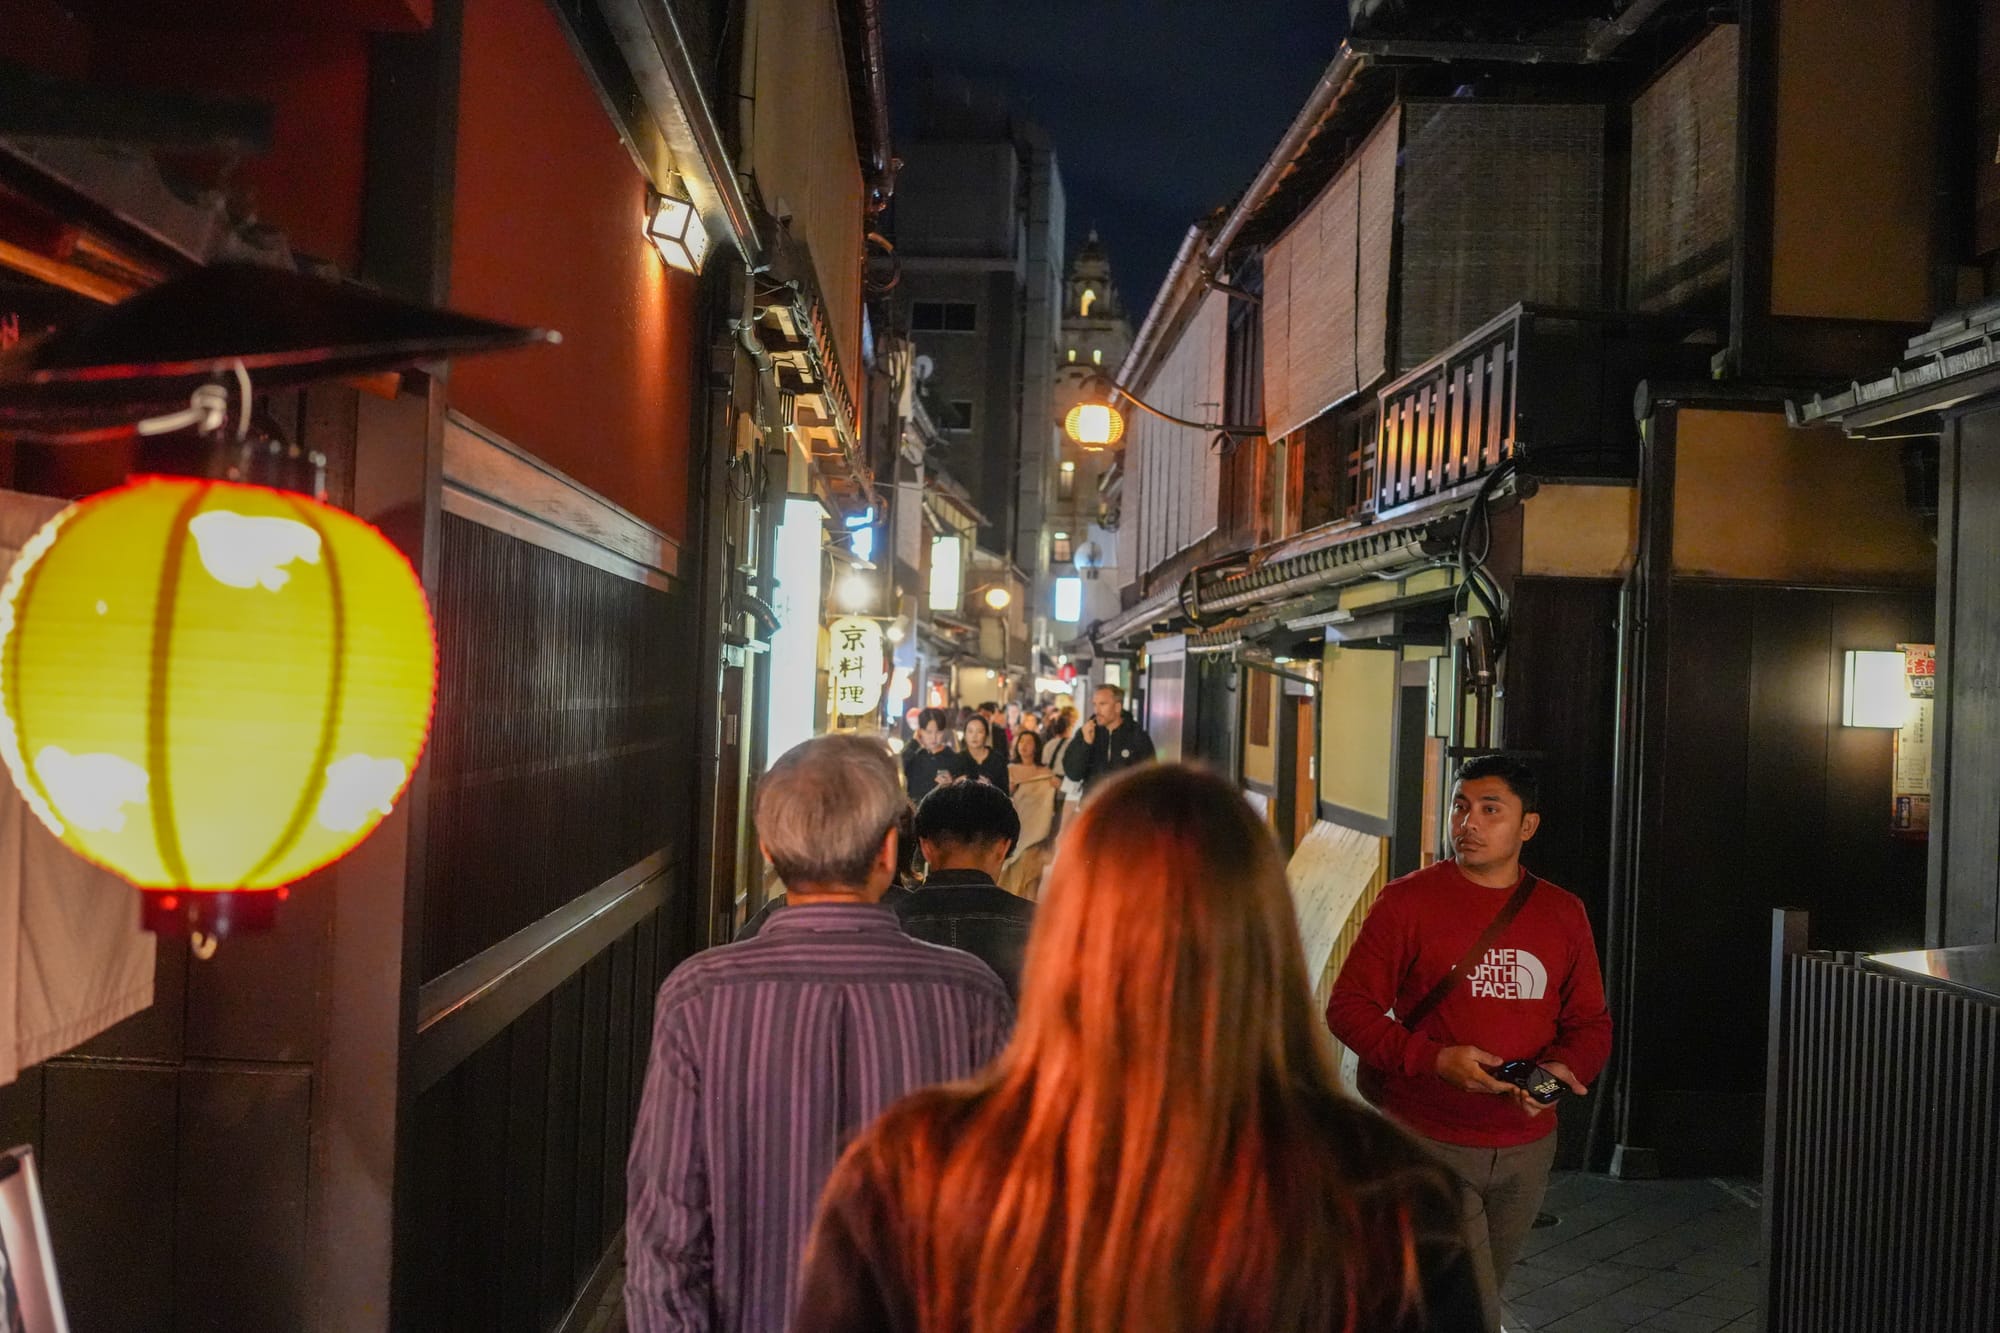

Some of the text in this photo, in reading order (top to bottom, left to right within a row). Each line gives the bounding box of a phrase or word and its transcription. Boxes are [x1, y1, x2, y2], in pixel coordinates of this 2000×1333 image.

[839, 625, 867, 704] 京料理
[1451, 964, 1517, 983] ORTH
[1471, 980, 1517, 1000] FACE
